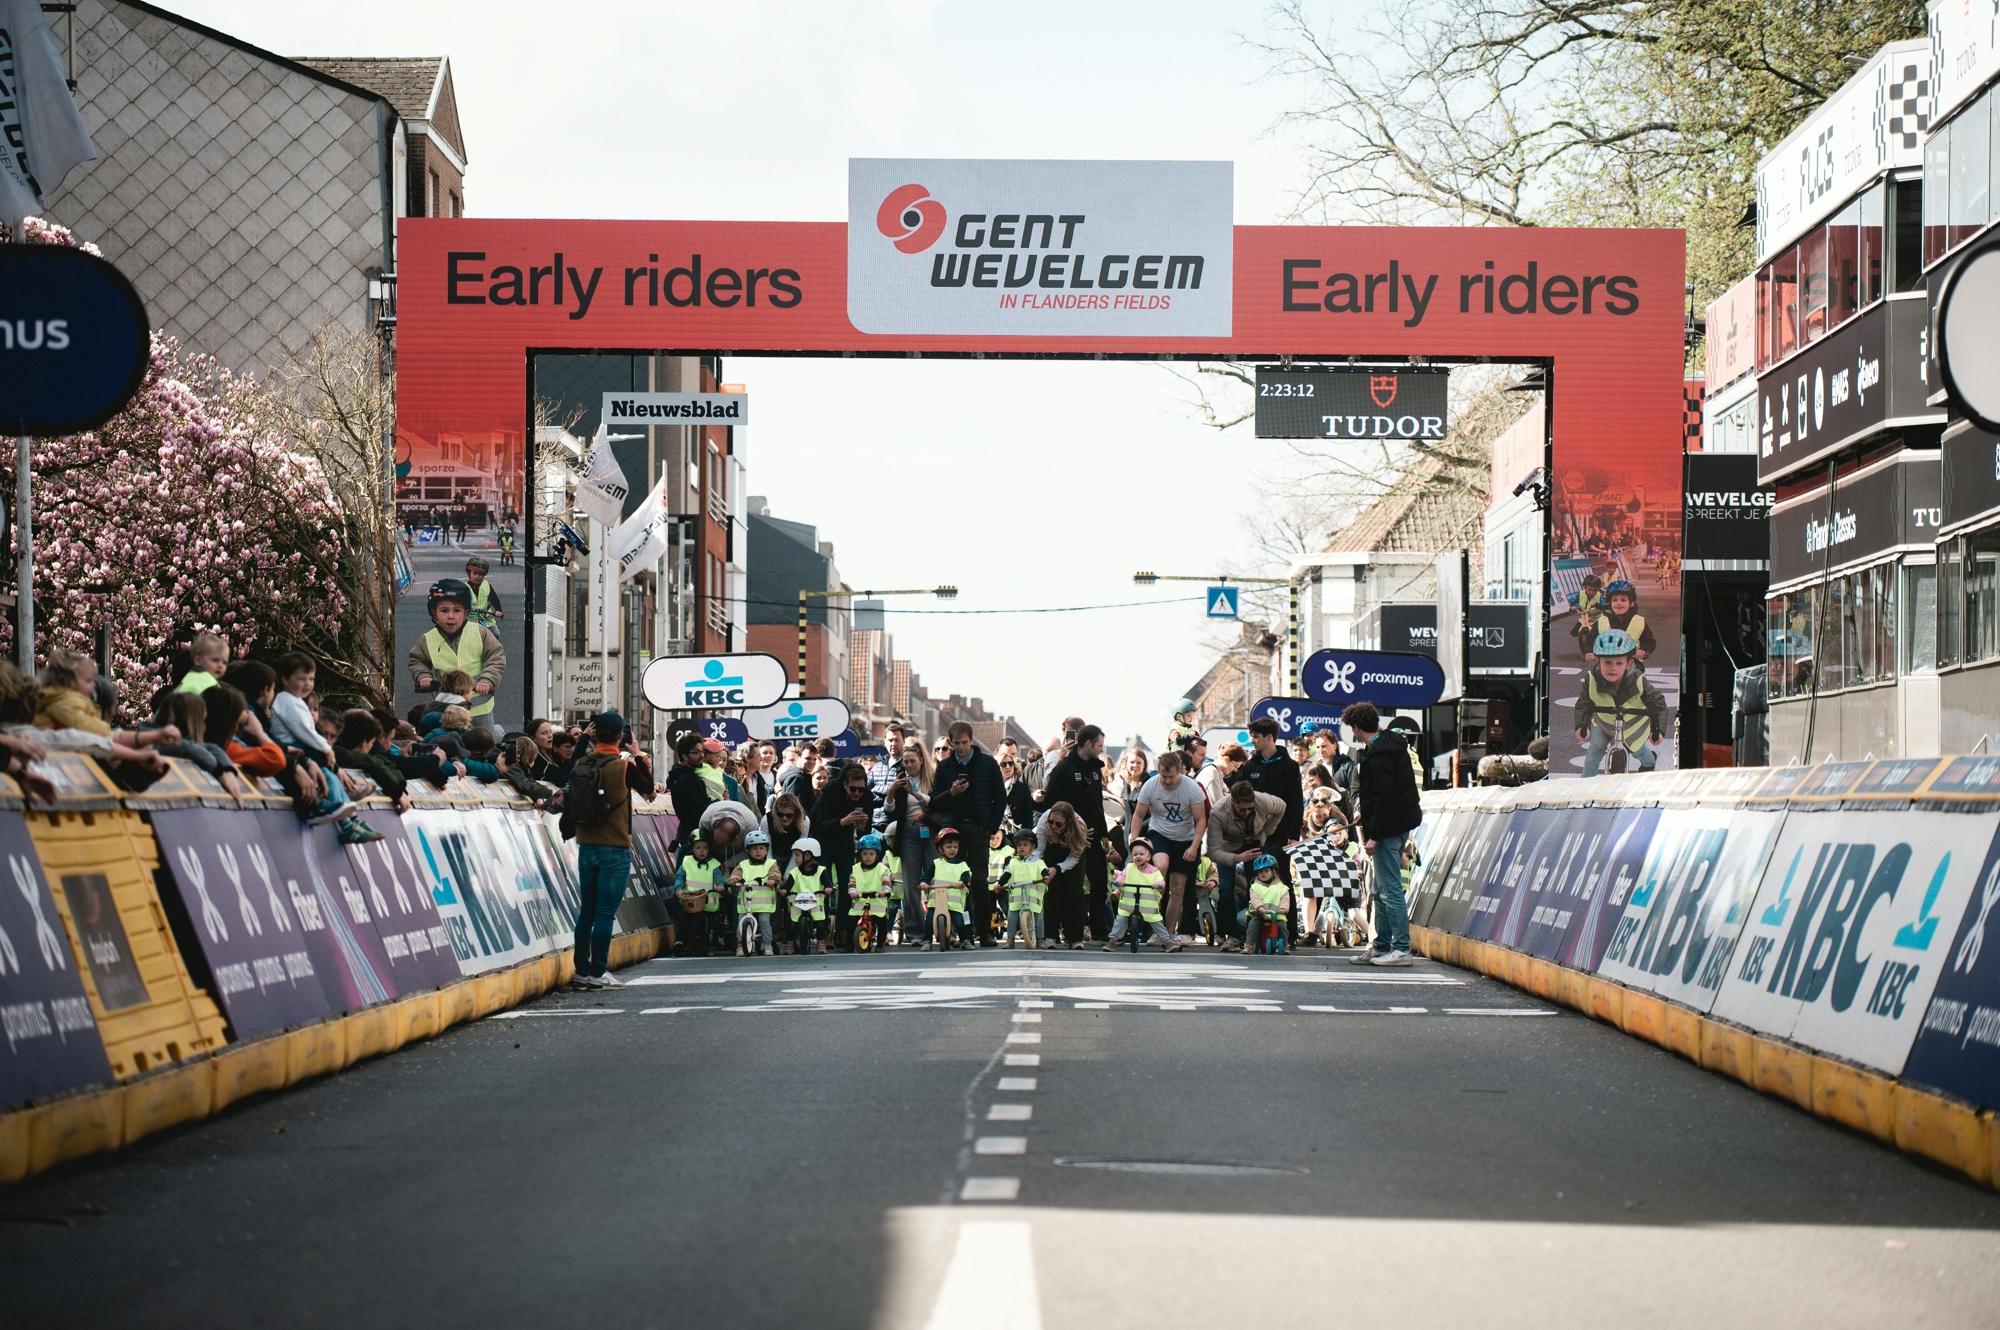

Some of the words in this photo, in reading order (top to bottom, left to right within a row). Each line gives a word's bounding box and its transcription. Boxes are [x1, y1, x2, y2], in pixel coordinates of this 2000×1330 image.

[954, 214, 1086, 249] GENT
[930, 253, 1205, 290] WEVELGEM
[447, 251, 603, 320] Early
[624, 253, 803, 309] riders
[1282, 259, 1438, 328] Early
[1459, 260, 1640, 316] riders
[999, 294, 1019, 309] IN
[1021, 294, 1109, 310] FLANDERS
[1113, 295, 1171, 310] FIELDS
[1260, 383, 1315, 398] 2:23:12
[610, 399, 740, 419] Nieuwsblad
[1322, 415, 1445, 438] TUDOR
[418, 464, 456, 476] sporza
[1685, 492, 1777, 507] WEVELGE
[1686, 508, 1741, 520] SPREEKT
[1744, 508, 1761, 520] JE
[1409, 638, 1438, 647] SPREE
[580, 661, 601, 671] Koffi
[1361, 672, 1425, 686] proximus
[684, 689, 744, 706] KBC
[773, 724, 818, 738] KBC
[1295, 715, 1344, 727] proximus
[1628, 827, 1750, 986] KBC
[1766, 842, 1913, 1013] KBC
[443, 914, 478, 962] KBC
[1605, 916, 1641, 963] KBC
[1697, 935, 1736, 992] KBC
[1738, 935, 1775, 985] KBC
[1866, 959, 1920, 1021] KBC
[488, 1000, 1558, 1020] proximus
